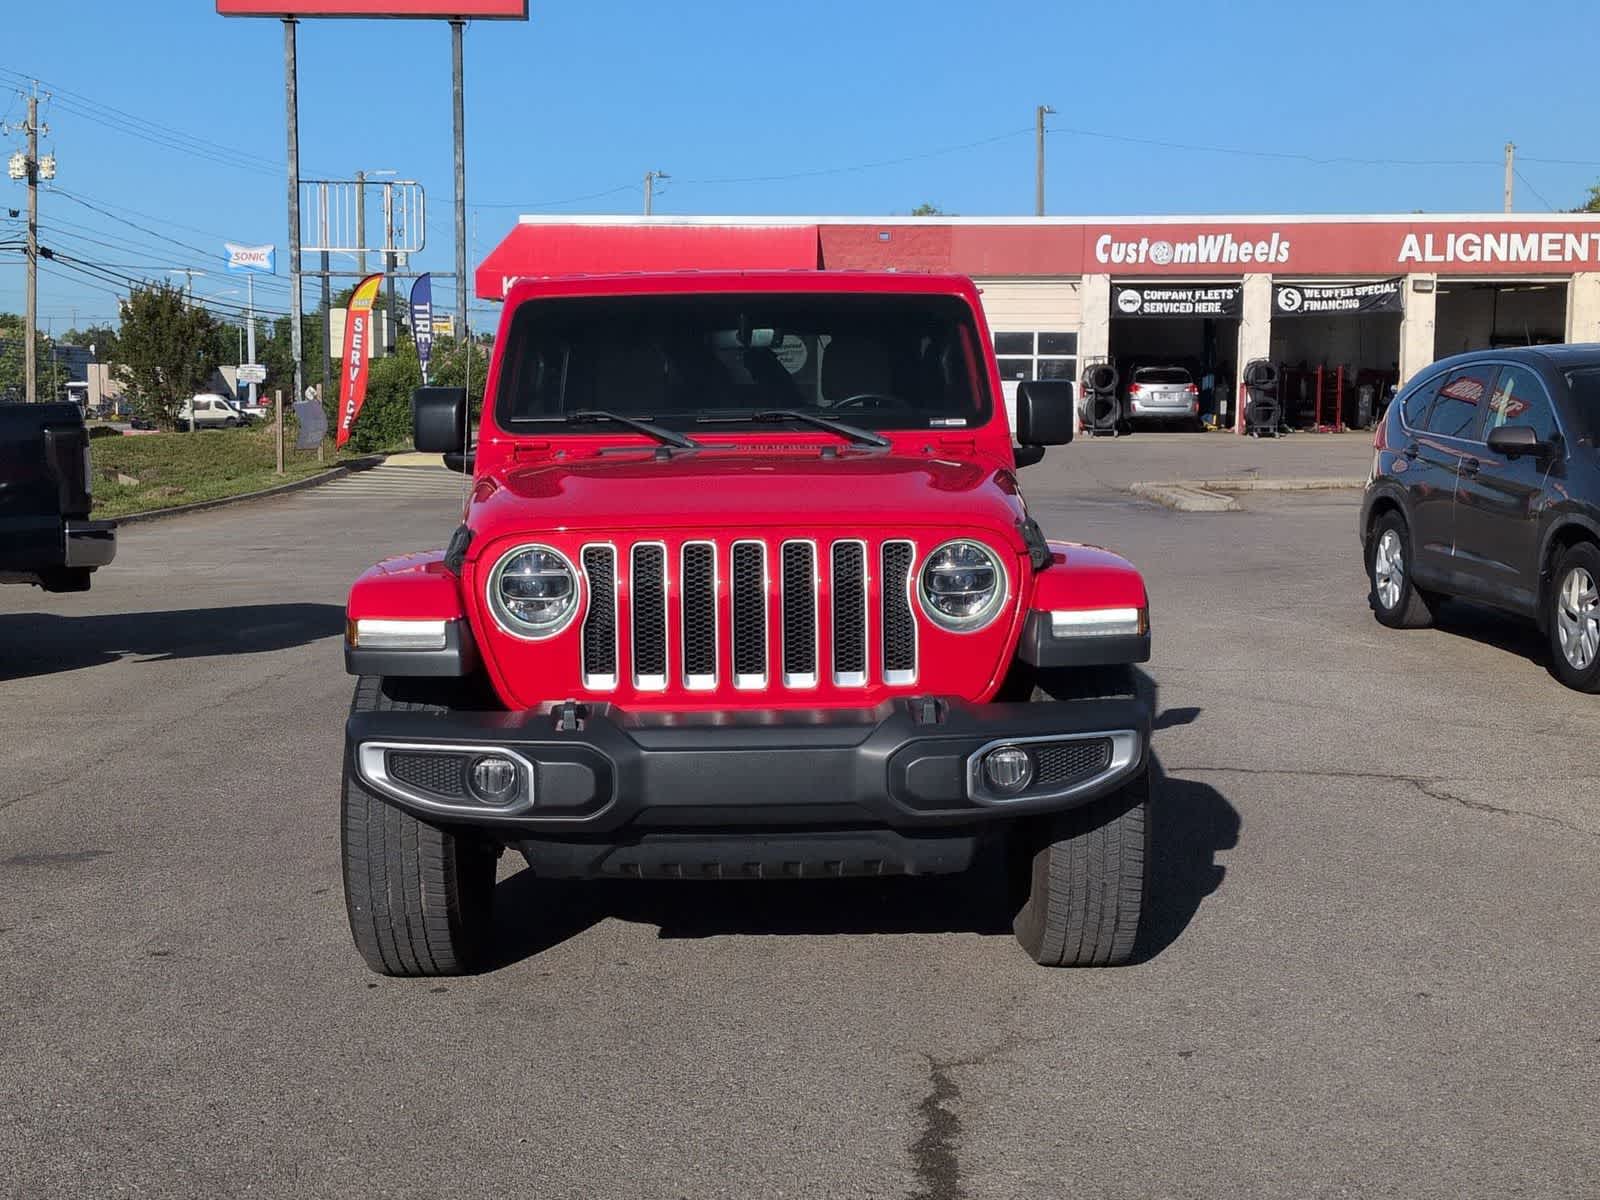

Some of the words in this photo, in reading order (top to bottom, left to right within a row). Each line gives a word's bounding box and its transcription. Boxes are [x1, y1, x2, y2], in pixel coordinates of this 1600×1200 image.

[233, 251, 265, 262] SONIC
[1143, 289, 1194, 300] COMPANY
[1195, 288, 1234, 300] FLEETS
[1303, 288, 1321, 298] WE
[1355, 283, 1398, 297] SPECIAL
[1143, 302, 1193, 313] SERVICED
[1194, 301, 1222, 313] HERE
[1303, 298, 1360, 311] FINANCING
[343, 316, 363, 429] SERVICE
